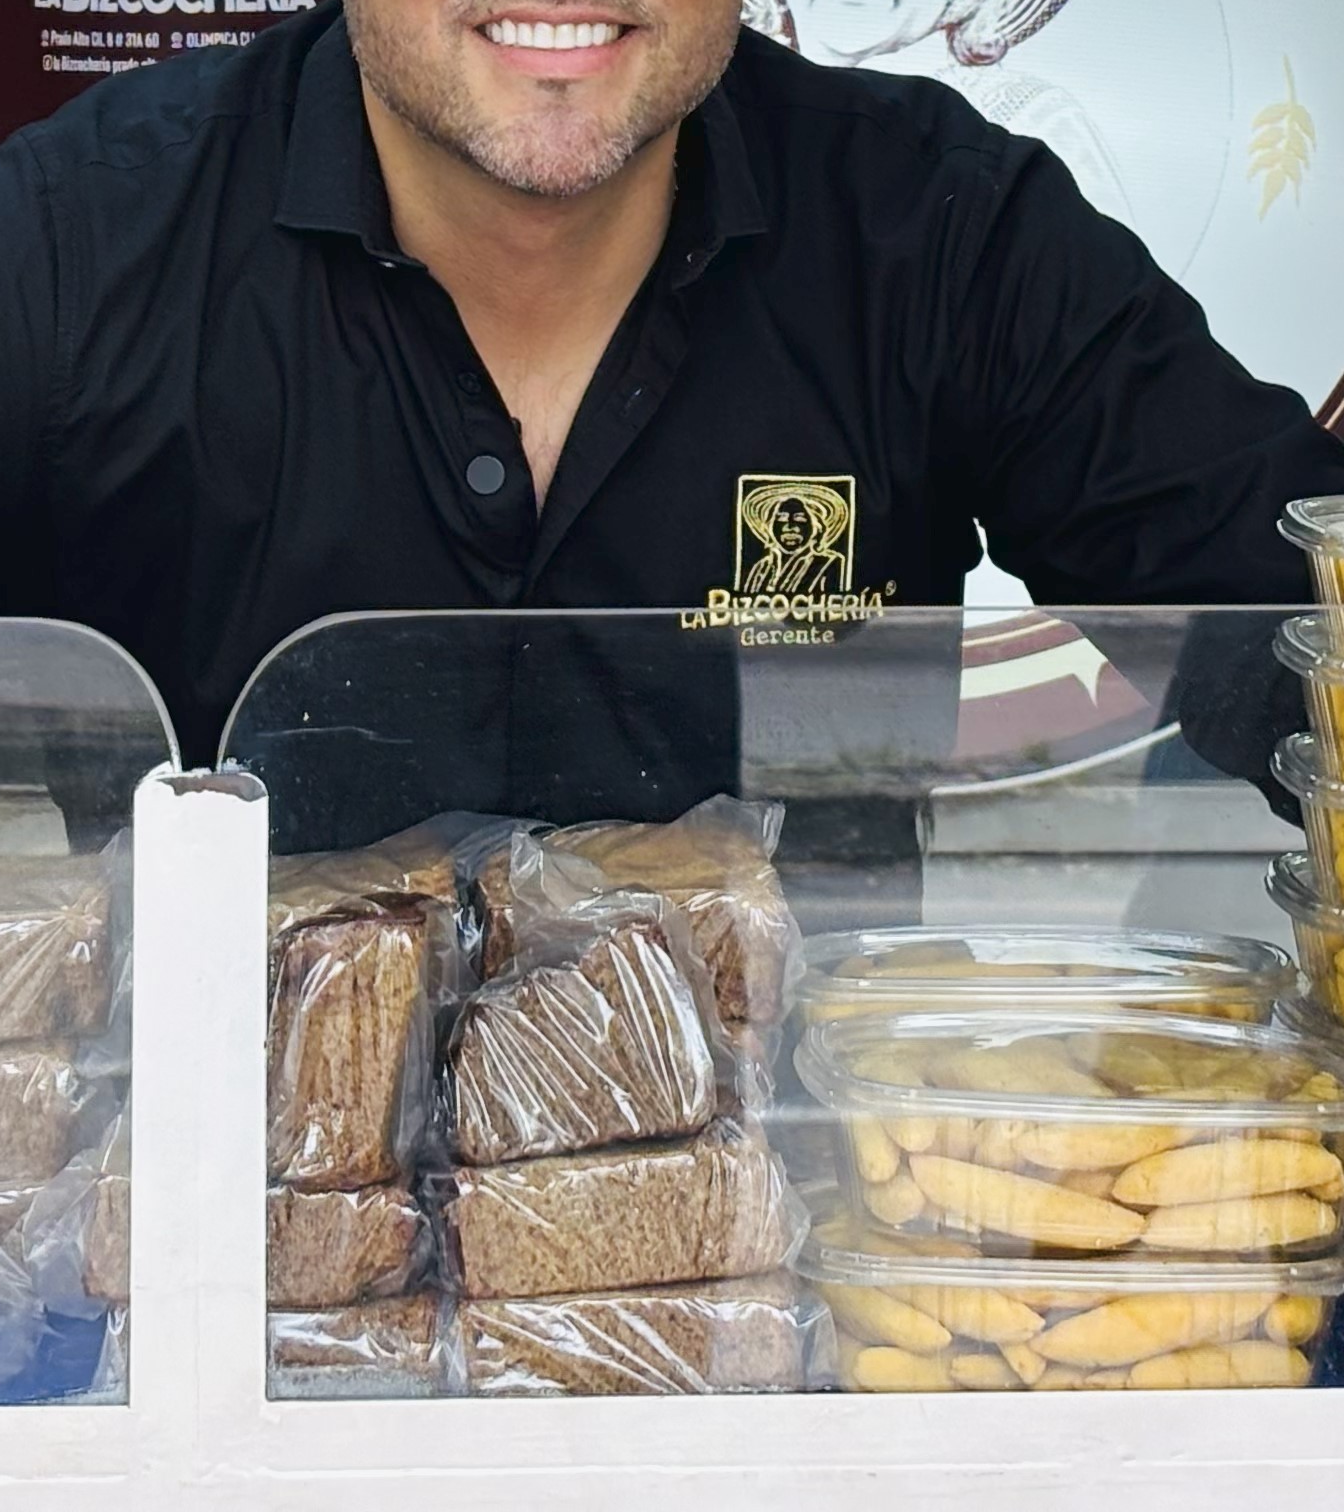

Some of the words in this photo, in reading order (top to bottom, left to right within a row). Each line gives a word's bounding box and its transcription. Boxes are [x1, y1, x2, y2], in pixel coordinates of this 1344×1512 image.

[680, 611, 706, 629] LA
[708, 587, 884, 627] BIZCOCHERÍA
[741, 625, 835, 646] Gerente
